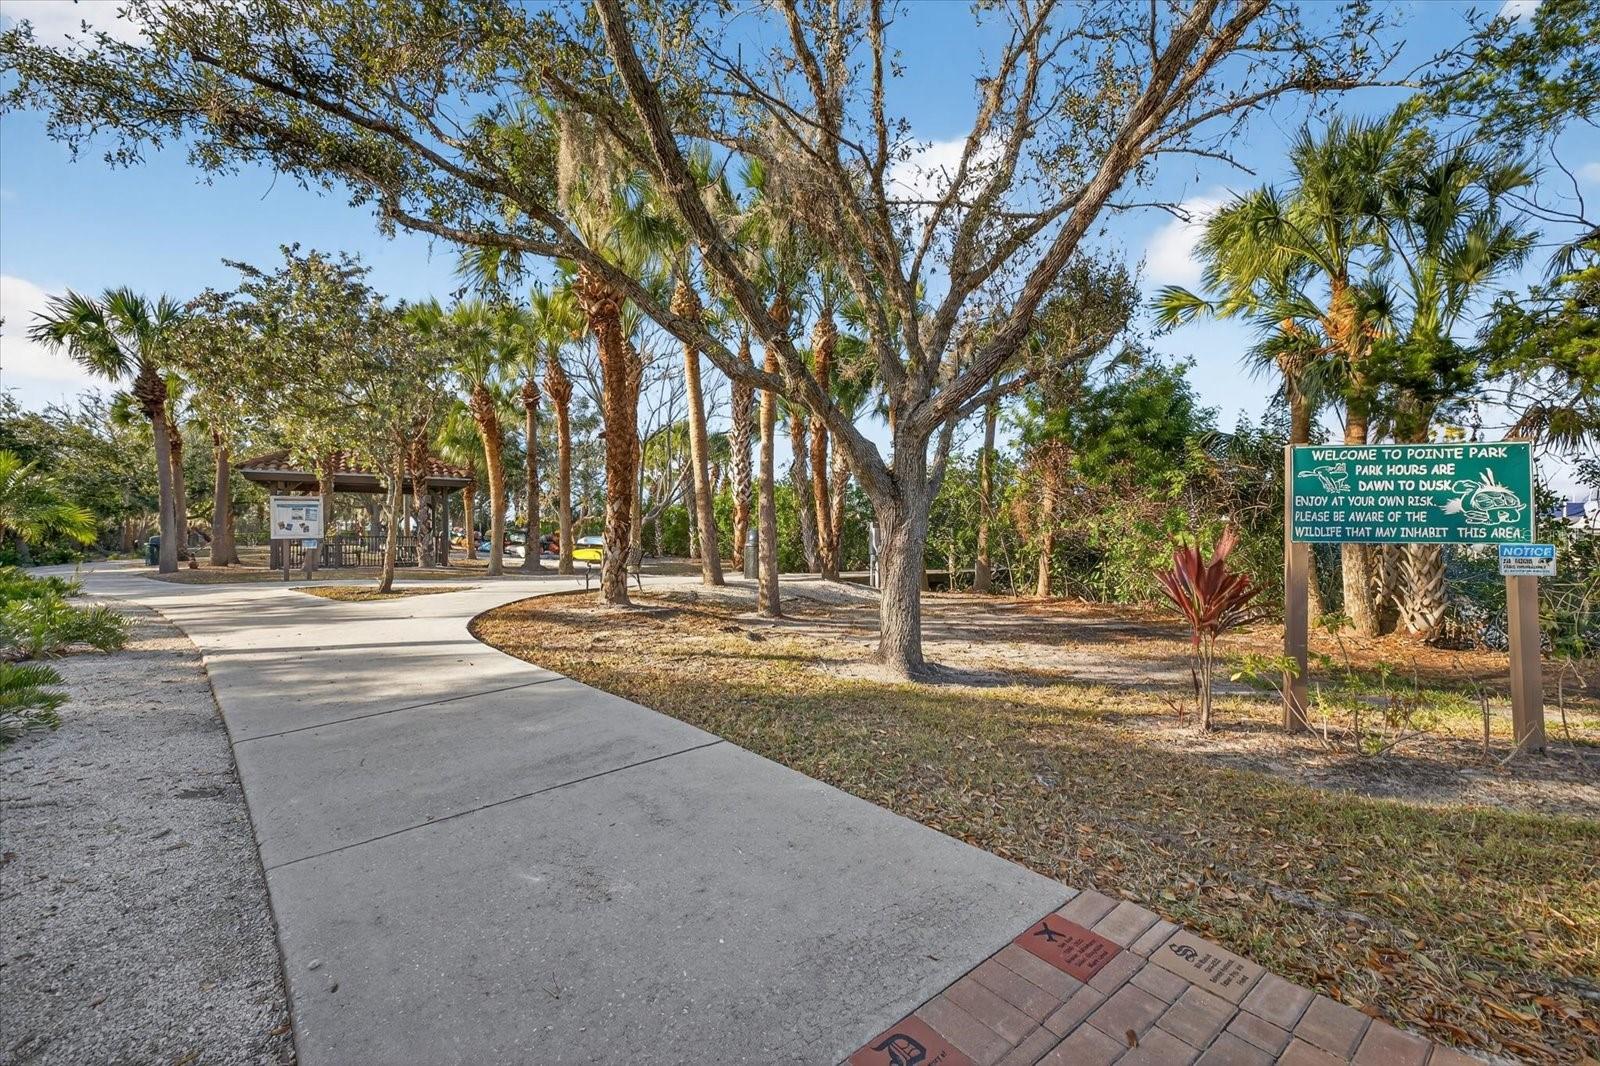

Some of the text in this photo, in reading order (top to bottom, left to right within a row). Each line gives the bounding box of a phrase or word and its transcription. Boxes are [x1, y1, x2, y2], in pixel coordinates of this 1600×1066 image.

[1312, 447, 1508, 460] WELCOME TO POINTE PARK
[1355, 463, 1455, 476] PARK HOURS ARE
[1358, 480, 1453, 491] DAWN TO DUSK
[1295, 496, 1437, 506] ENJOY AT YOUR OWN RISK.
[1295, 511, 1427, 522] PLEASE BE AWARE OF THE
[1294, 526, 1341, 537] WILDLIFE
[1345, 527, 1372, 537] THAT
[1375, 527, 1397, 537] MAY
[1400, 527, 1448, 538] INHABIT
[1457, 527, 1487, 538] THIS
[1503, 547, 1553, 556] NOTICE
